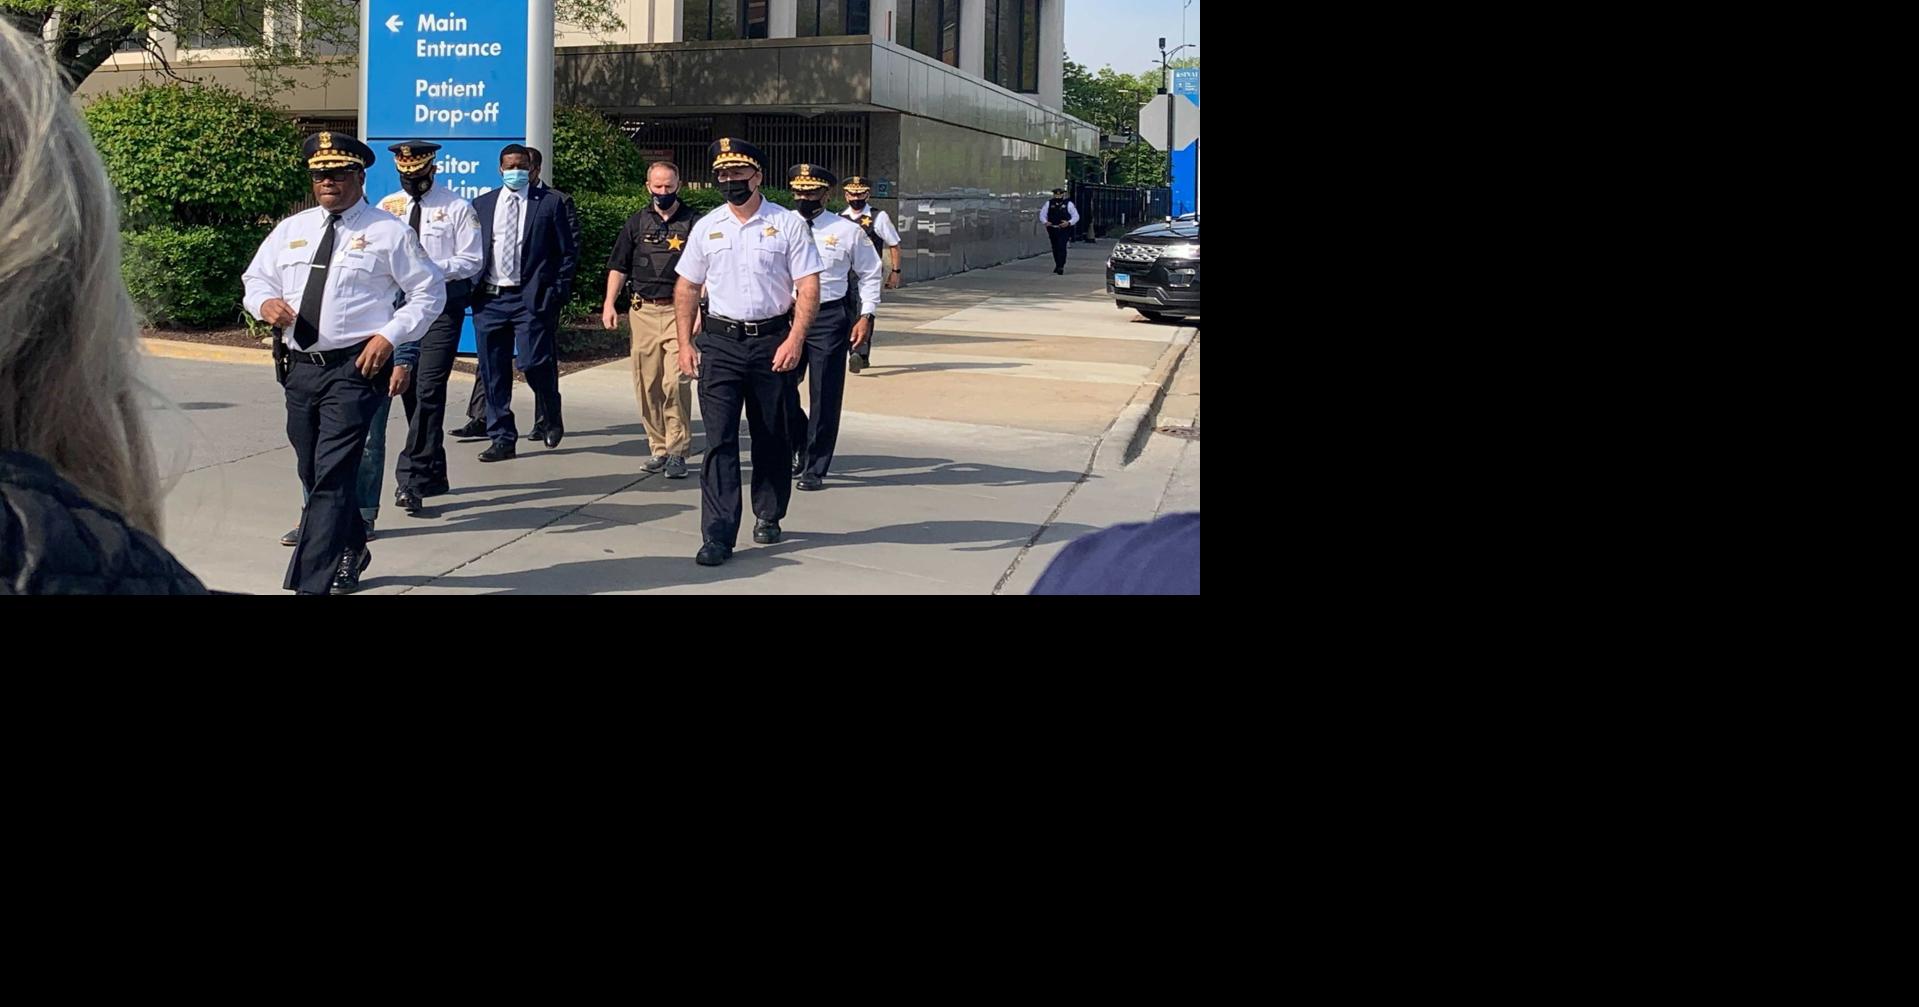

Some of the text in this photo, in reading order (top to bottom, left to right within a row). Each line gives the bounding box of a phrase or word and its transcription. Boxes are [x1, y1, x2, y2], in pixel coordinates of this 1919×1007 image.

[417, 12, 467, 32] Main
[416, 39, 502, 57] Entrance
[416, 78, 485, 97] Patient
[415, 102, 499, 128] Drop-off
[435, 154, 480, 174] sitor
